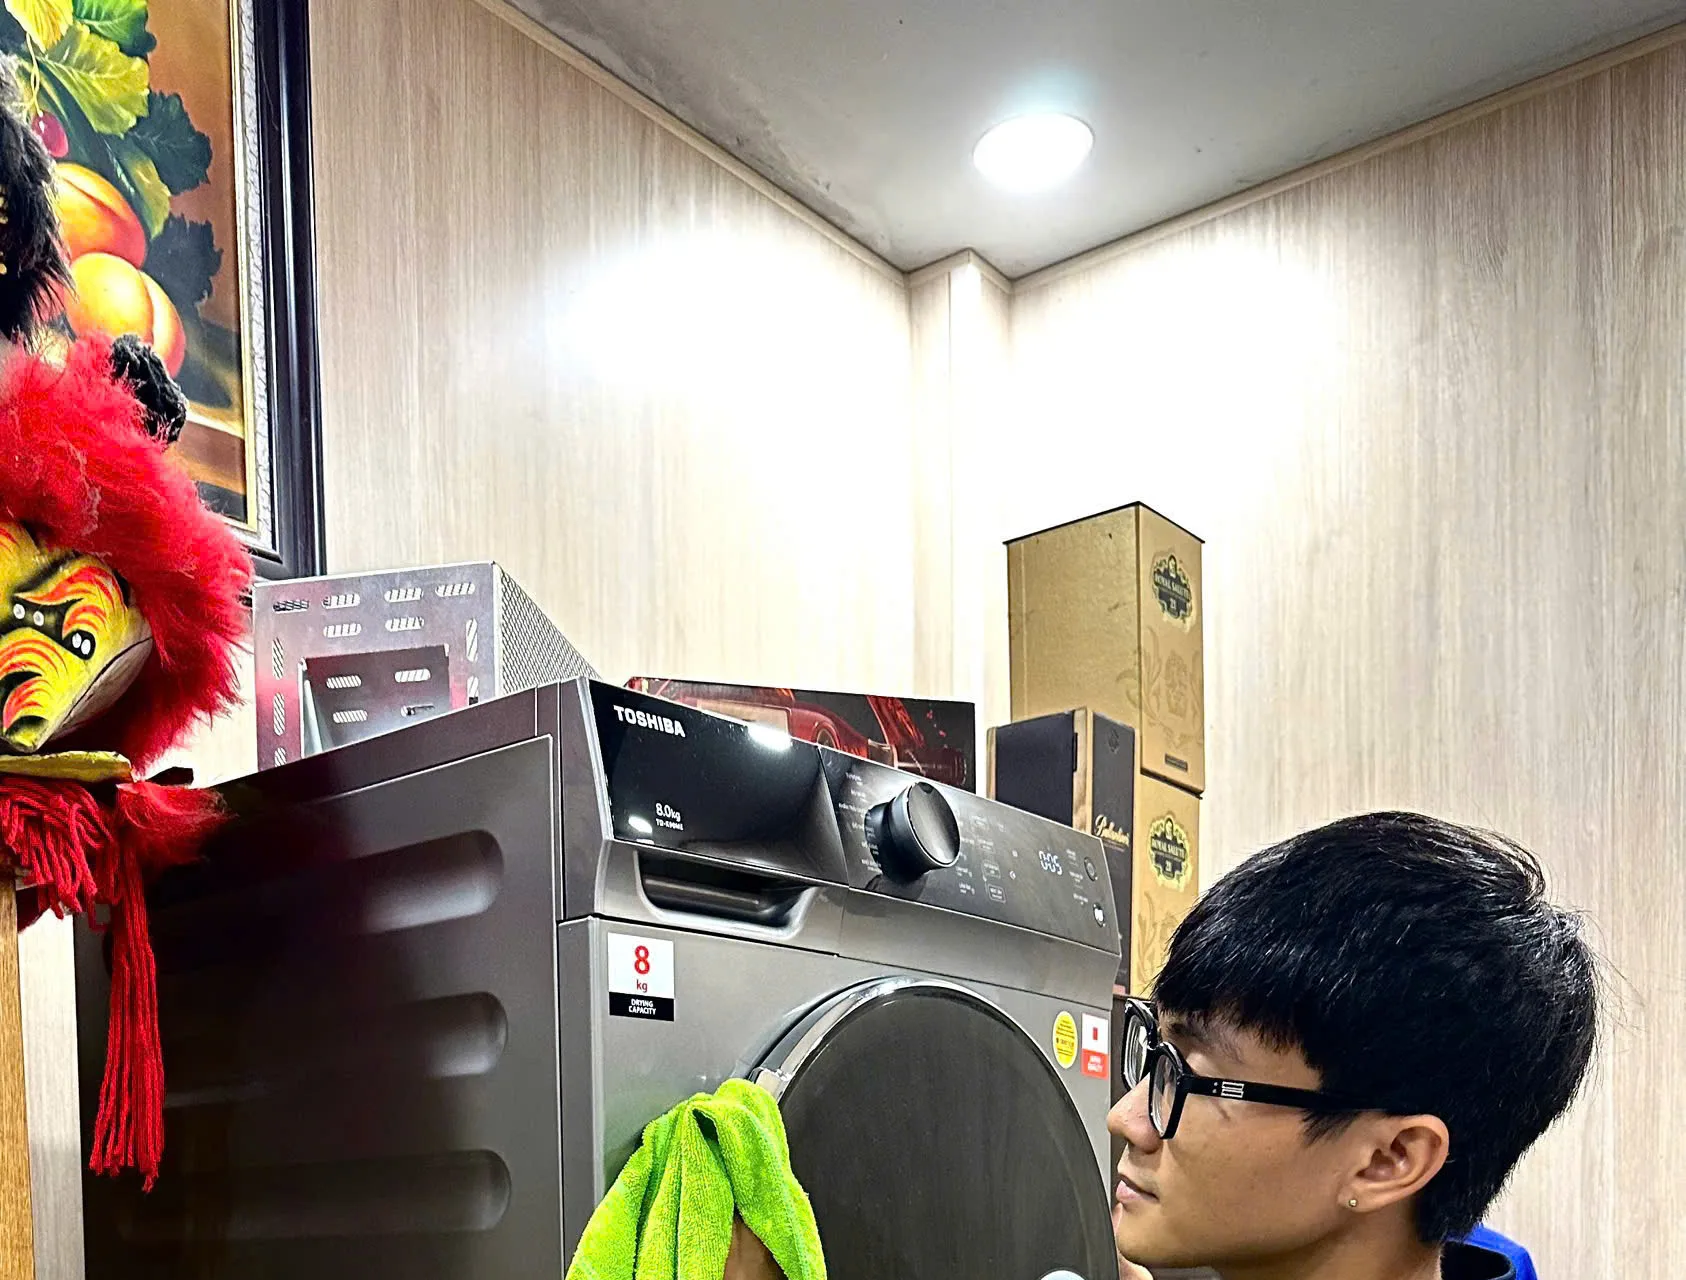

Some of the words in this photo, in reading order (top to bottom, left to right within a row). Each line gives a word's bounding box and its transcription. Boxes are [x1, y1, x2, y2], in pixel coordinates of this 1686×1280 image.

[613, 704, 686, 738] TOSHIBA
[655, 802, 682, 823] 8.0kg
[634, 945, 650, 975] 8
[636, 978, 648, 993] kg
[628, 1005, 657, 1016] CAPACITY
[630, 998, 654, 1008] DRYING
